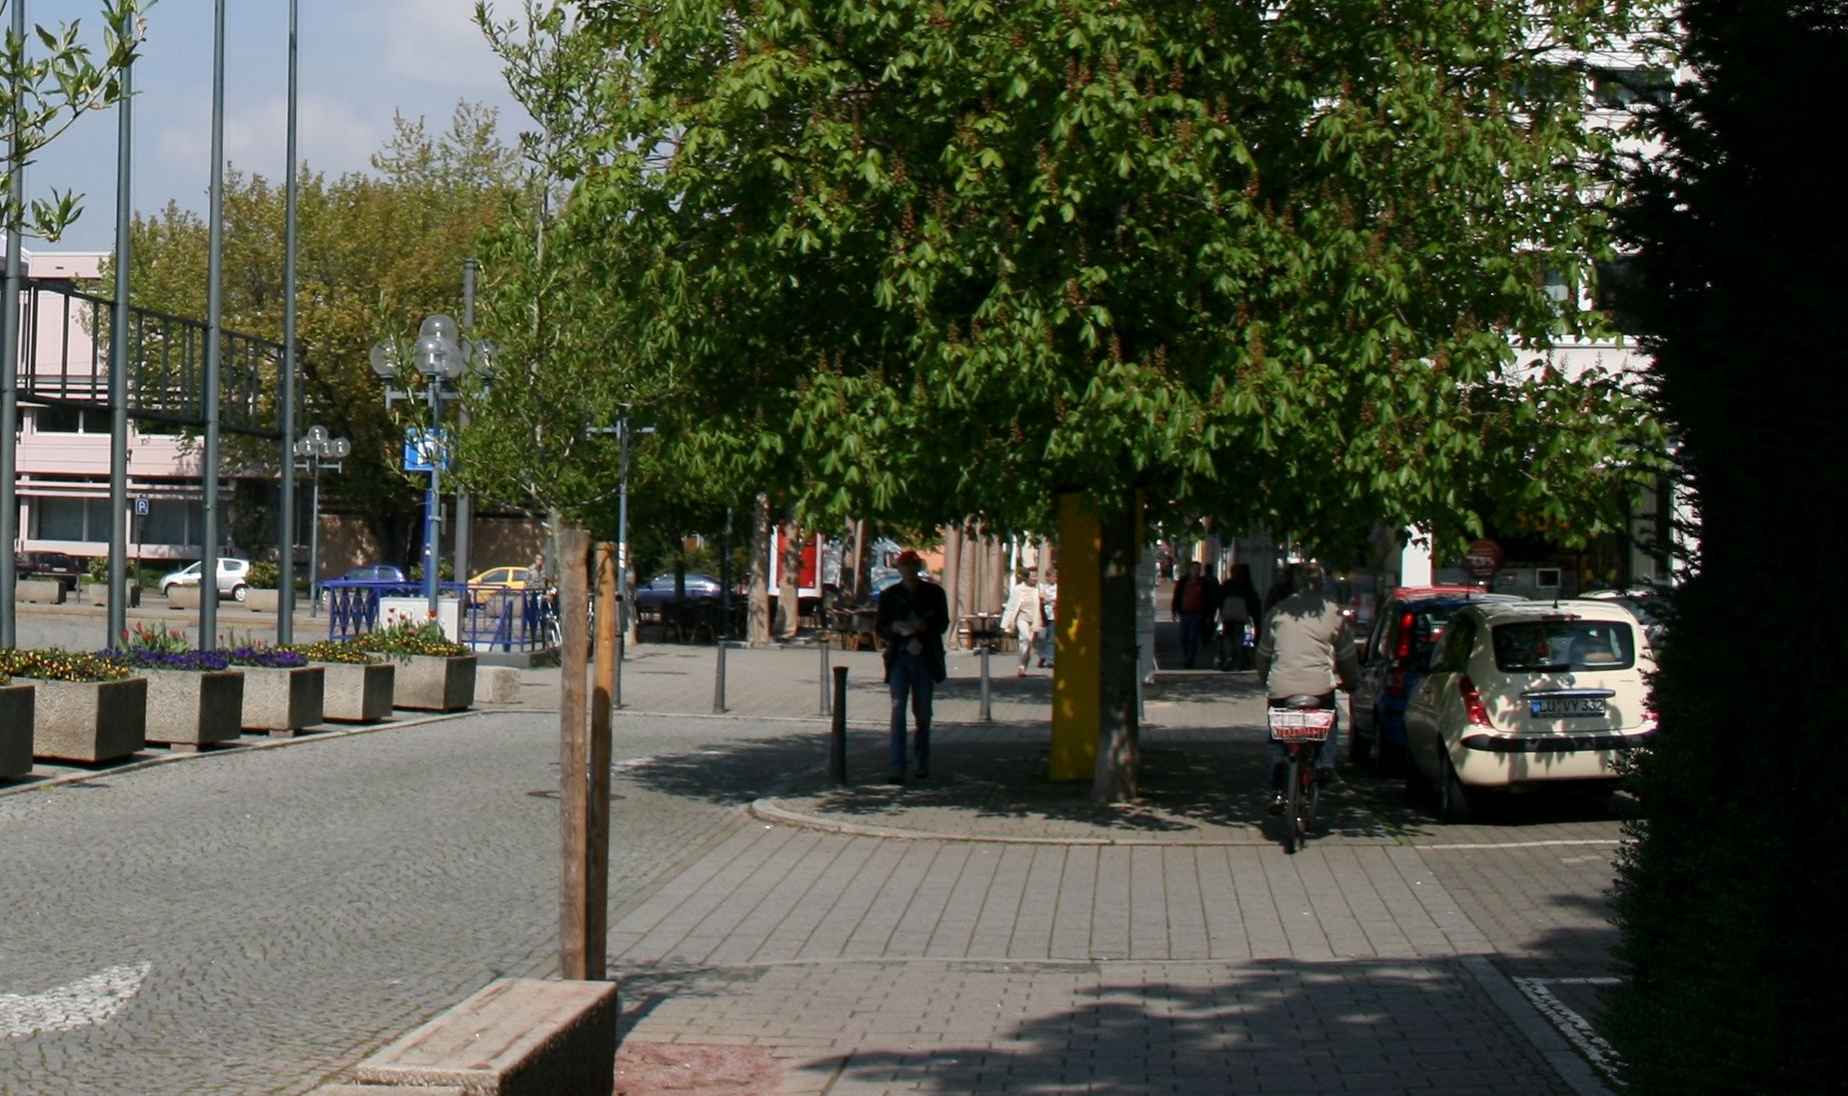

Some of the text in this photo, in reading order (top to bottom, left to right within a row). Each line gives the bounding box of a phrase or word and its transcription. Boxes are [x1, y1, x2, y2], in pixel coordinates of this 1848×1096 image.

[138, 501, 146, 513] P
[1539, 698, 1604, 713] LU VY 332
